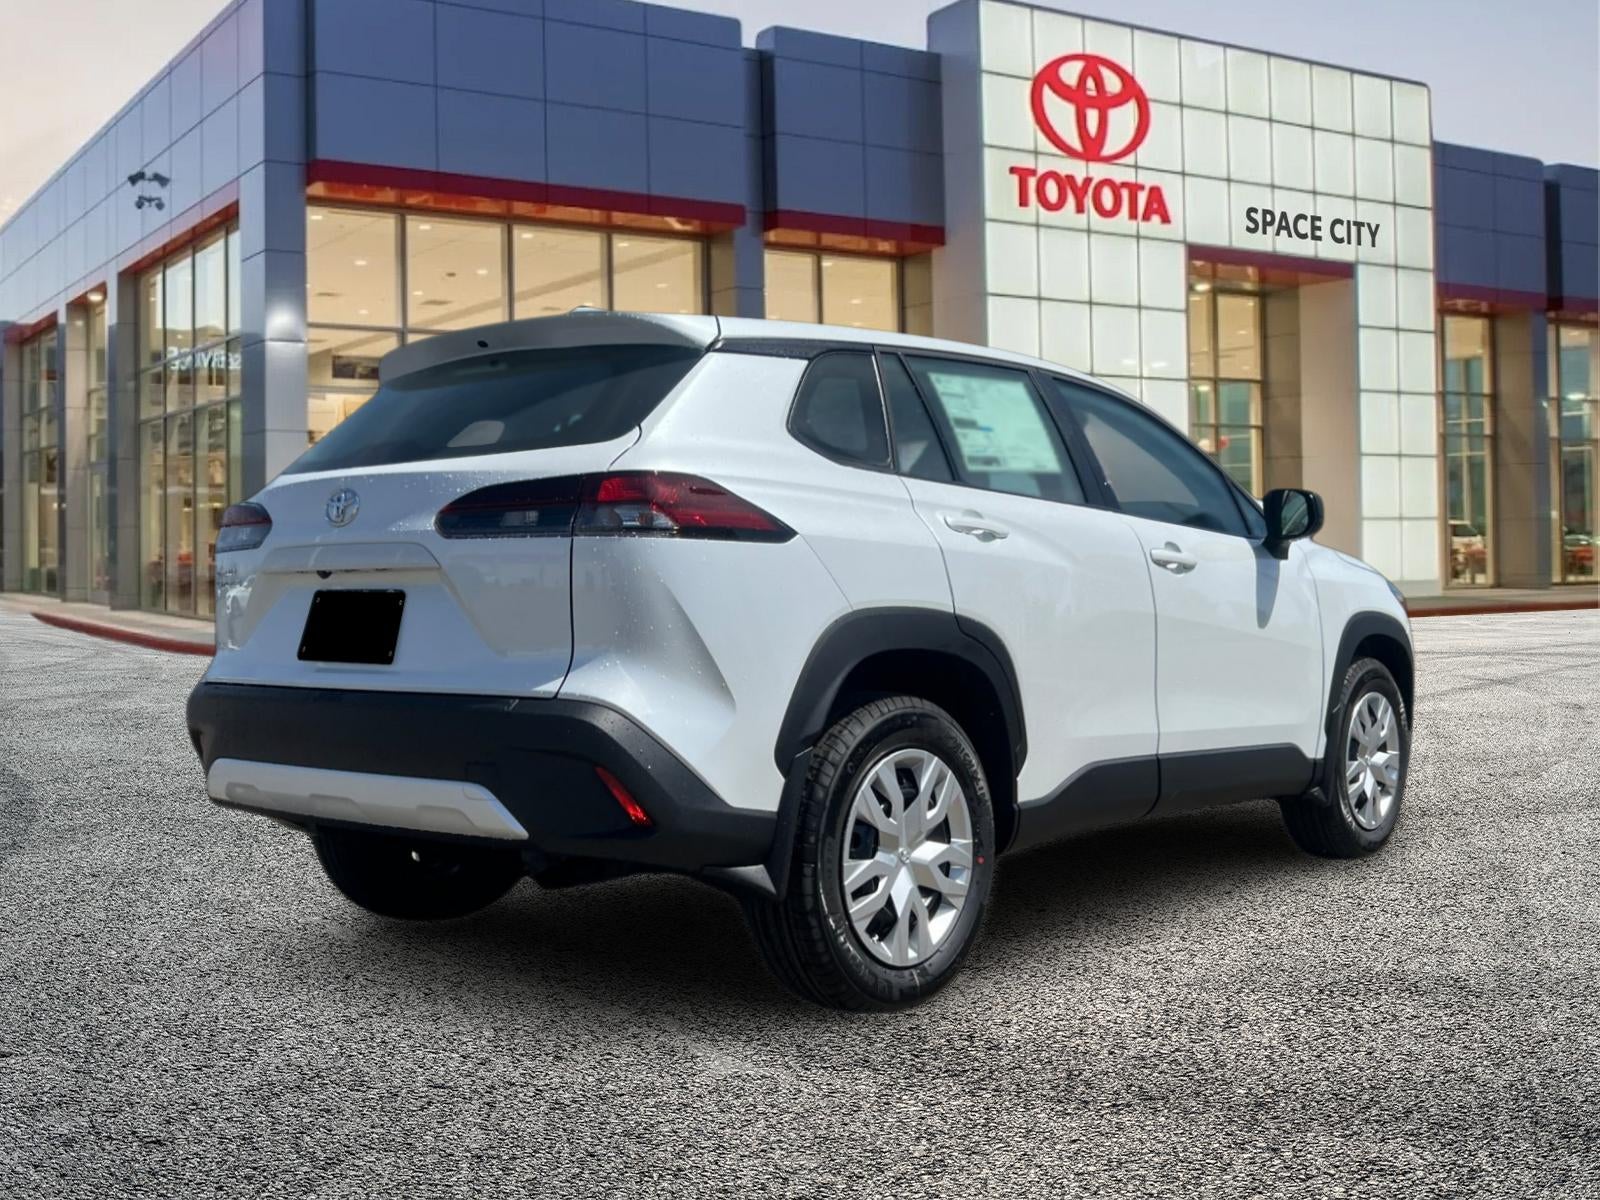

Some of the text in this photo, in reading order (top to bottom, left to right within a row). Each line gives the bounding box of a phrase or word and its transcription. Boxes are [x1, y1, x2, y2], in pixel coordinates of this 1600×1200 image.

[1008, 166, 1171, 225] TOYOTA
[1245, 207, 1381, 248] SPACE CITY
